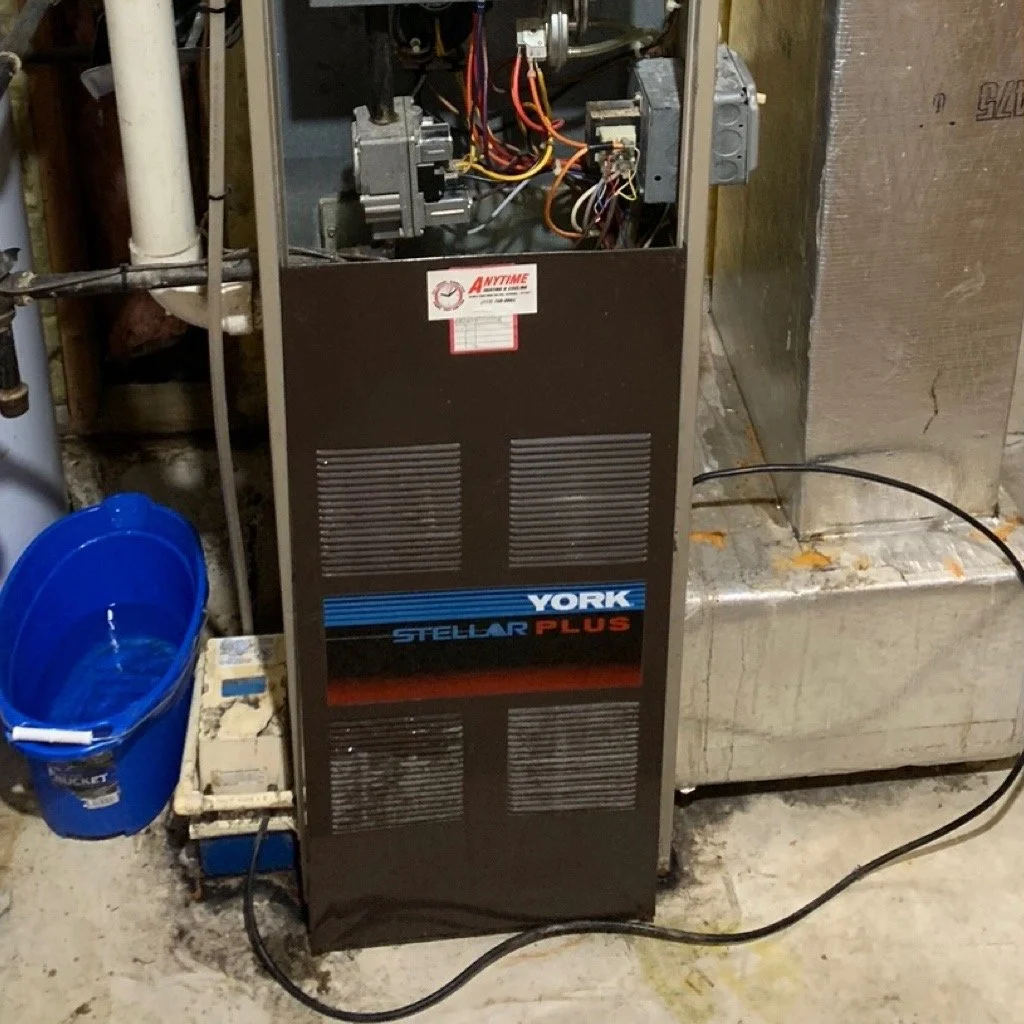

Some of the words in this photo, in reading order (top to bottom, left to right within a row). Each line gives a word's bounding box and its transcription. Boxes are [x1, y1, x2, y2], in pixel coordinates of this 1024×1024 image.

[468, 273, 530, 294] ANYTIME
[527, 590, 632, 613] YORK
[392, 621, 529, 645] STELLAR
[535, 616, 631, 636] PLUS
